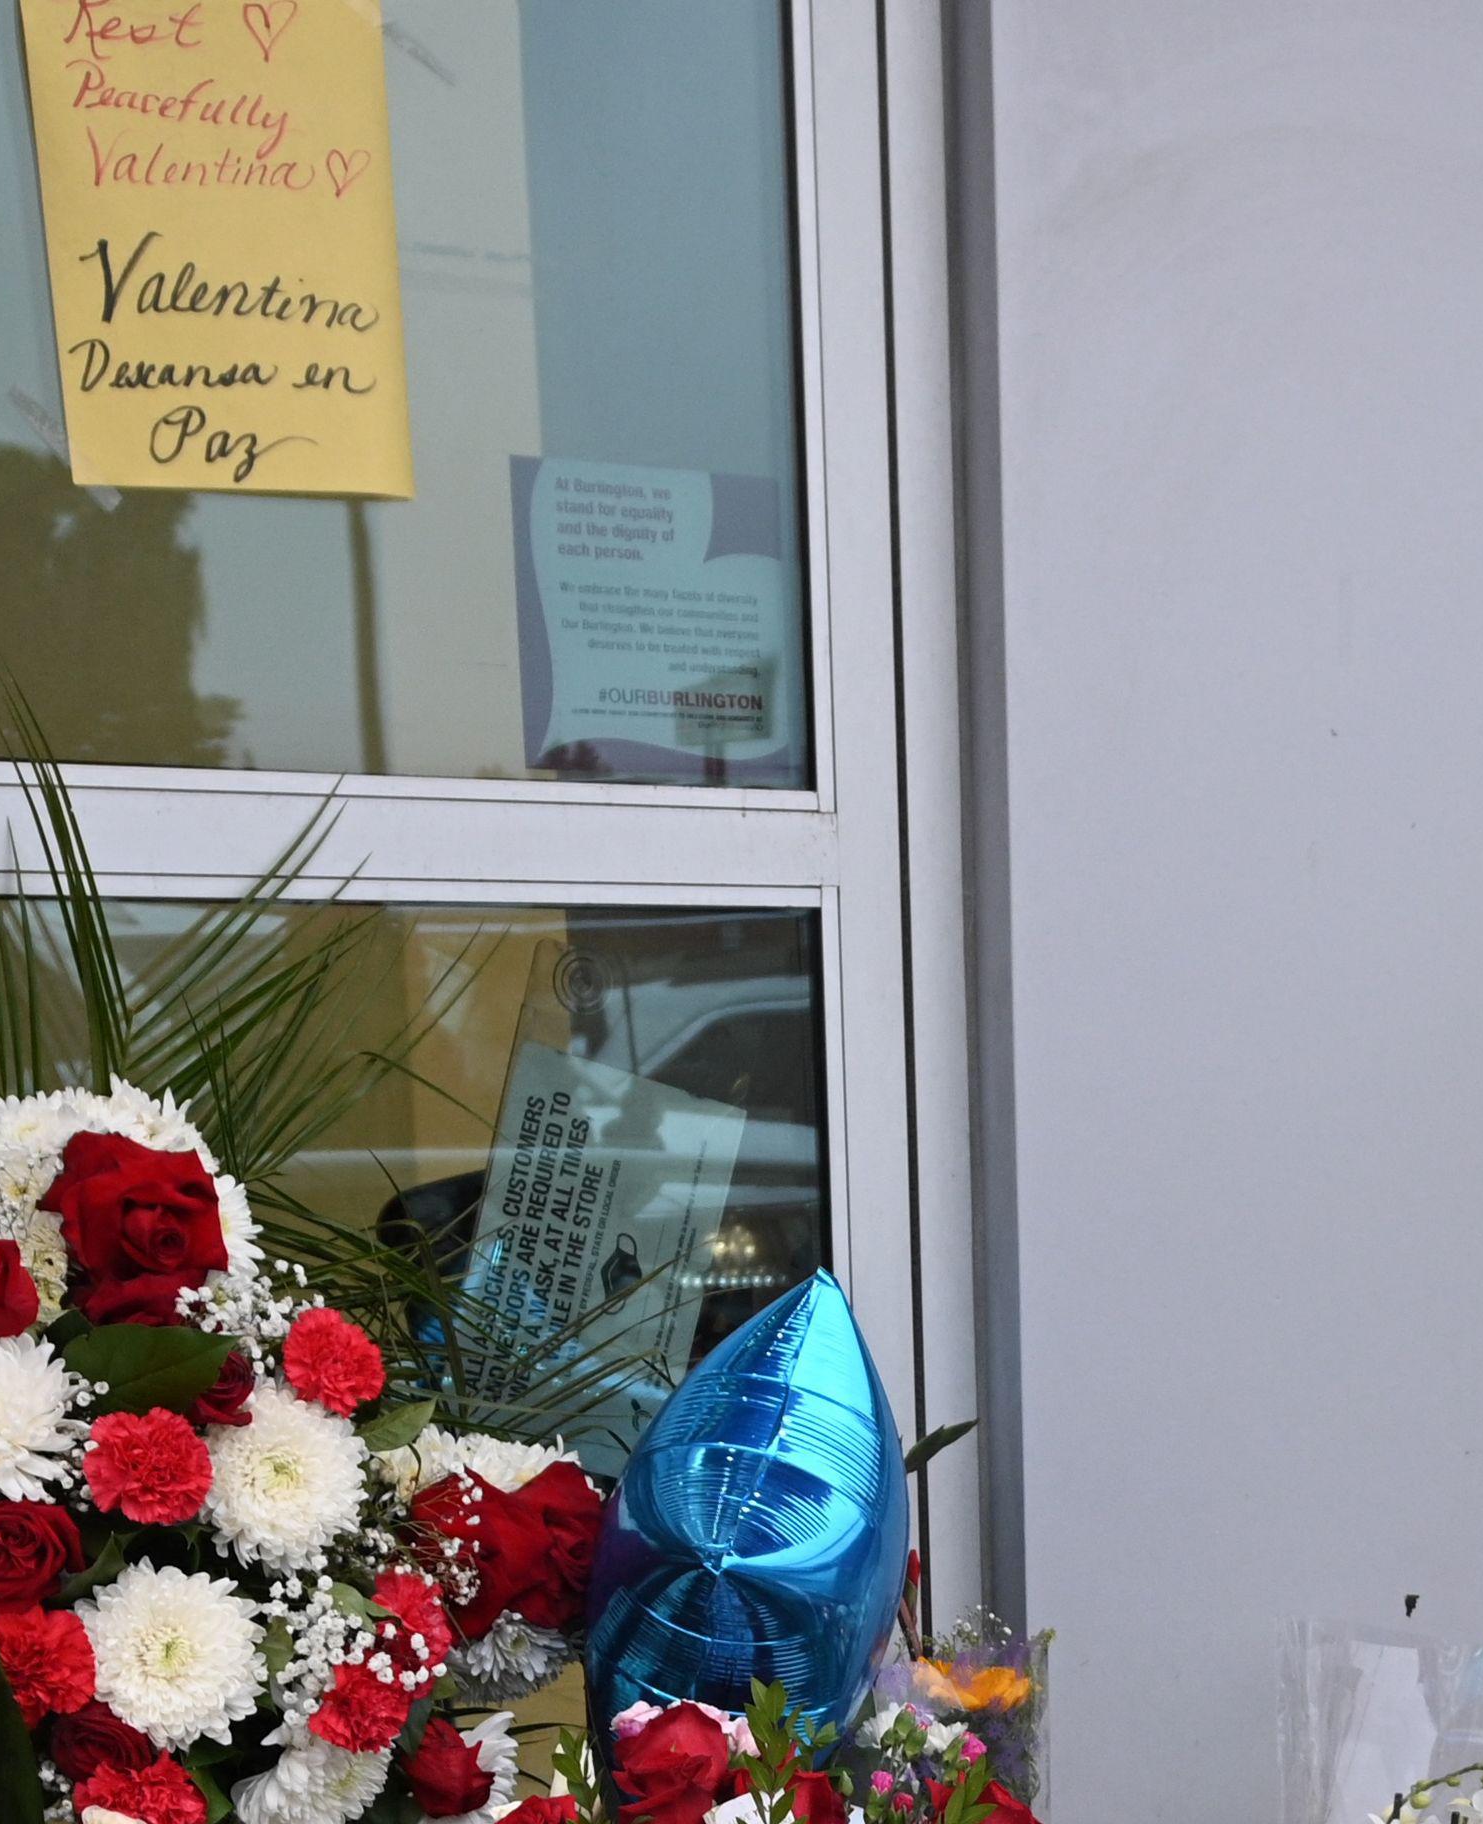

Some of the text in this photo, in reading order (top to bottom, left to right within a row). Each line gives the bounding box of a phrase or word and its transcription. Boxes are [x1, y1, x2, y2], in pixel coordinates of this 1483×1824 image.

[66, 59, 288, 160] Peacefully
[87, 125, 315, 191] Valentina
[79, 231, 380, 332] Valentina
[292, 362, 378, 394] en
[149, 405, 319, 483] Paz
[556, 499, 674, 524] stand for equality
[557, 522, 675, 543] and the dignity of
[558, 543, 644, 561] each person.
[599, 687, 763, 711] #OURBURLINGTON
[548, 1090, 572, 1118] TO
[501, 1095, 546, 1216] CUSTOMERS
[525, 1122, 563, 1219] REQUIRED
[548, 1180, 575, 1220] ALL
[573, 1164, 602, 1227] STORE
[513, 1222, 541, 1264] ARE
[541, 1222, 565, 1251] AT
[590, 1229, 605, 1256] STATE
[600, 1188, 615, 1216] LOCAL
[562, 1231, 588, 1269] THE
[527, 1255, 560, 1319] MASK,
[557, 1273, 577, 1295] IN
[508, 1341, 536, 1400] WER
